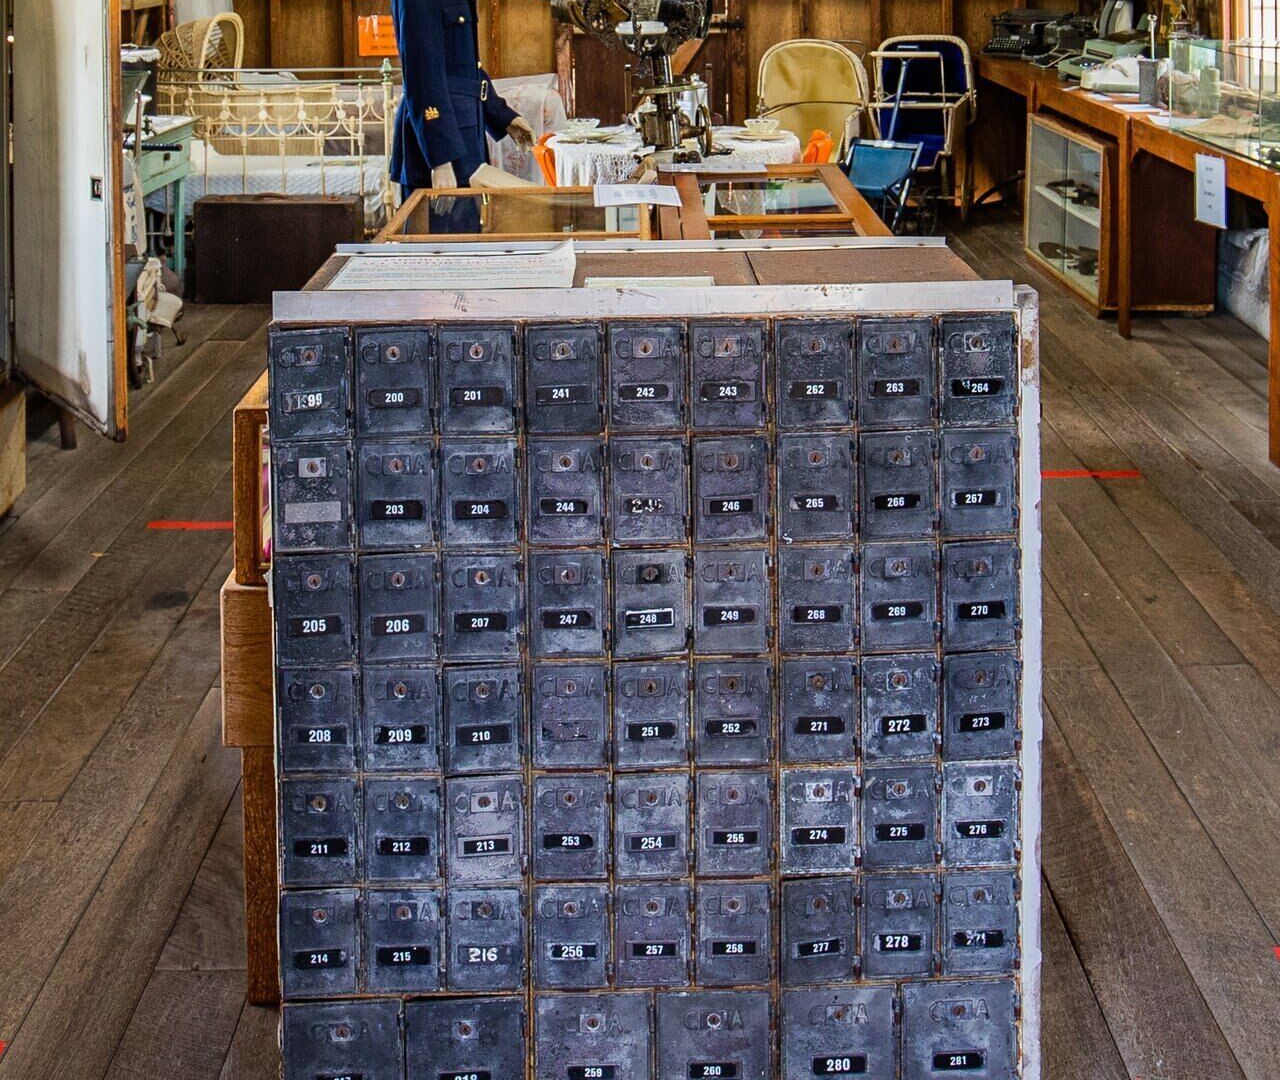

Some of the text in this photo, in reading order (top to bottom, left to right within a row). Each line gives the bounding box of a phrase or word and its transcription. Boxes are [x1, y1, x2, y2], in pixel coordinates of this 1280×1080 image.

[636, 387, 655, 397] 242
[719, 386, 738, 397] 243
[806, 384, 825, 395] 262
[886, 382, 904, 393] 263
[971, 383, 989, 393] 264
[385, 392, 404, 403] 200
[463, 390, 481, 401] 201
[552, 388, 570, 399] 241
[805, 497, 824, 508] 265
[887, 496, 905, 508] 266
[965, 493, 983, 504] 267
[385, 504, 404, 515] 203
[471, 504, 490, 515] 204
[556, 502, 575, 512] 244
[722, 501, 740, 512] 246
[720, 610, 739, 621] 249
[807, 609, 825, 620] 268
[888, 606, 906, 617] 269
[970, 605, 988, 616] 270
[471, 617, 489, 628] 207
[559, 614, 578, 625] 247
[639, 614, 657, 624] 248
[302, 619, 327, 633] 205
[385, 618, 410, 633] 206
[810, 721, 828, 731] 271
[888, 718, 910, 732] 272
[972, 716, 990, 728] 273
[641, 726, 659, 737] 251
[722, 723, 740, 733] 252
[308, 729, 331, 743] 208
[388, 728, 412, 743] 209
[472, 730, 491, 742] 210
[809, 829, 828, 840] 274
[890, 826, 908, 837] 275
[969, 824, 987, 835] 276
[561, 835, 580, 846] 253
[641, 836, 663, 850] 254
[726, 833, 745, 843] 255
[310, 844, 328, 854] 211
[392, 841, 411, 852] 212
[476, 840, 495, 852] 213
[812, 941, 829, 953] 277
[885, 935, 909, 948] 278
[561, 945, 583, 959] 256
[645, 945, 664, 955] 257
[725, 943, 744, 953] 258
[310, 953, 328, 964] 214
[392, 951, 411, 962] 215
[469, 947, 499, 962] 216
[826, 1058, 851, 1072] 280
[950, 1055, 967, 1066] 281
[584, 1067, 603, 1078] 259
[703, 1065, 721, 1076] 260
